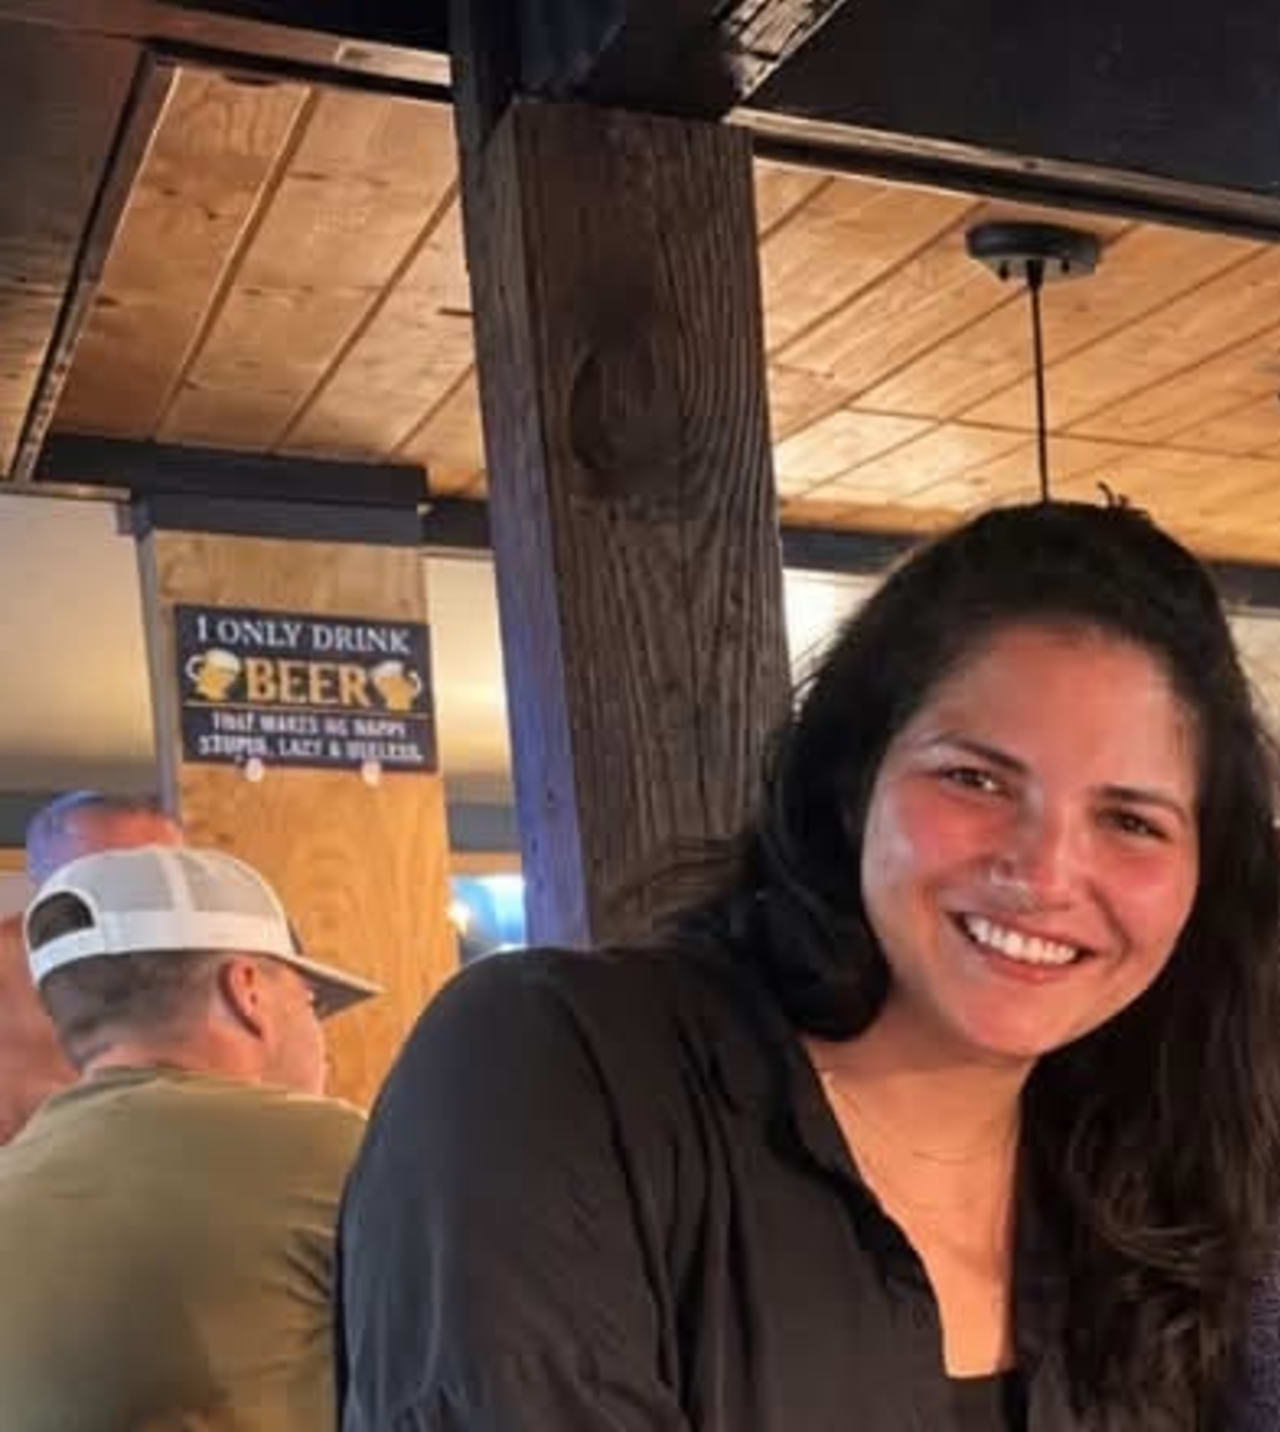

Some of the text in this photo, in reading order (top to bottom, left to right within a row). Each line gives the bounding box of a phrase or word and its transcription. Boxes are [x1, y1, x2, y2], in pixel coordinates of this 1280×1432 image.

[197, 615, 411, 653] I ONLY DRINK
[245, 656, 372, 709] BEER
